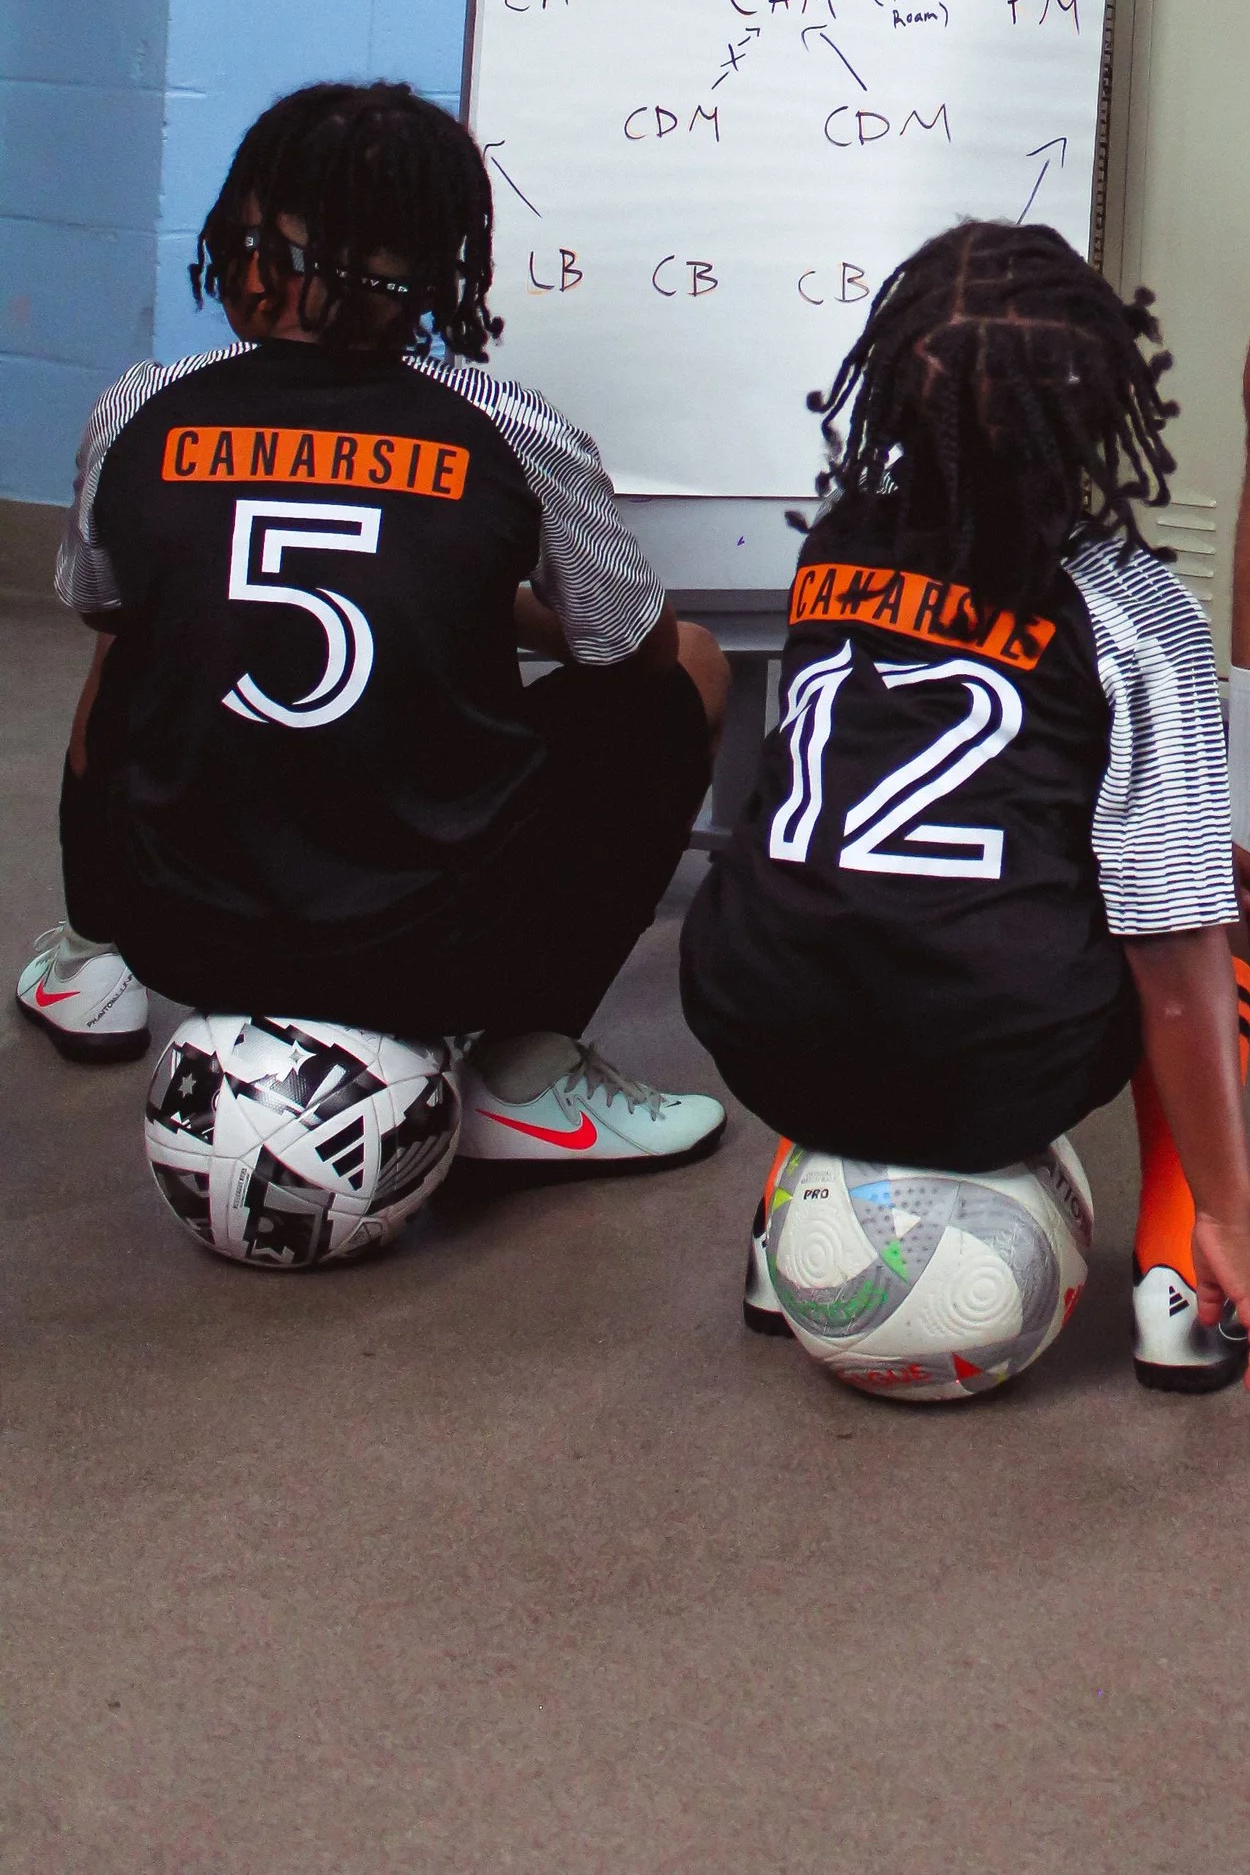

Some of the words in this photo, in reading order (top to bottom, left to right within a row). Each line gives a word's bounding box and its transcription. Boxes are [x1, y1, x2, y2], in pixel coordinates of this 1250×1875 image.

[623, 104, 721, 142] CDM
[824, 103, 950, 147] CDM
[529, 248, 583, 293] LB
[652, 255, 719, 297] CB
[797, 261, 871, 305] CB
[173, 429, 459, 495] CANARSIE
[221, 499, 382, 729] 5
[769, 638, 1024, 880] 12
[803, 1189, 830, 1200] PRO
